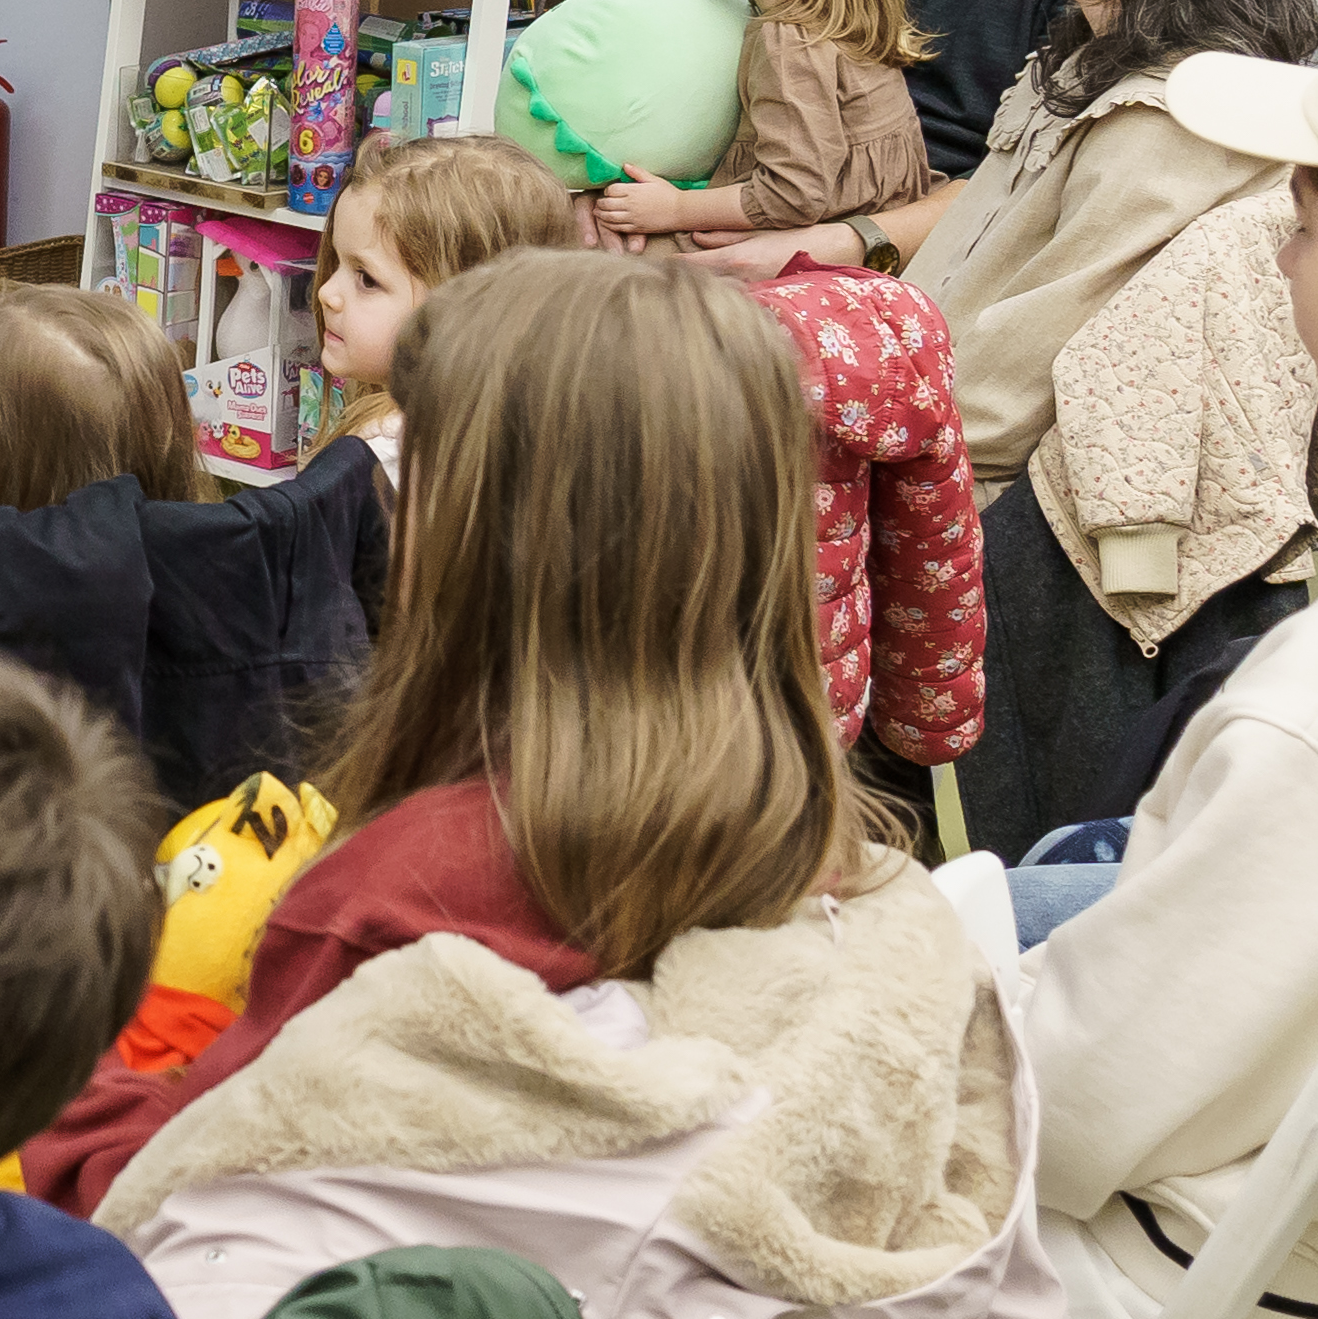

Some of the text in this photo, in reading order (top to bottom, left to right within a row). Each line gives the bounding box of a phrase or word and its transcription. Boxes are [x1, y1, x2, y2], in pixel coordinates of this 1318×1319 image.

[299, 129, 314, 154] 6
[230, 368, 265, 388] Pets
[235, 383, 264, 396] Alive
[227, 400, 249, 412] Mama
